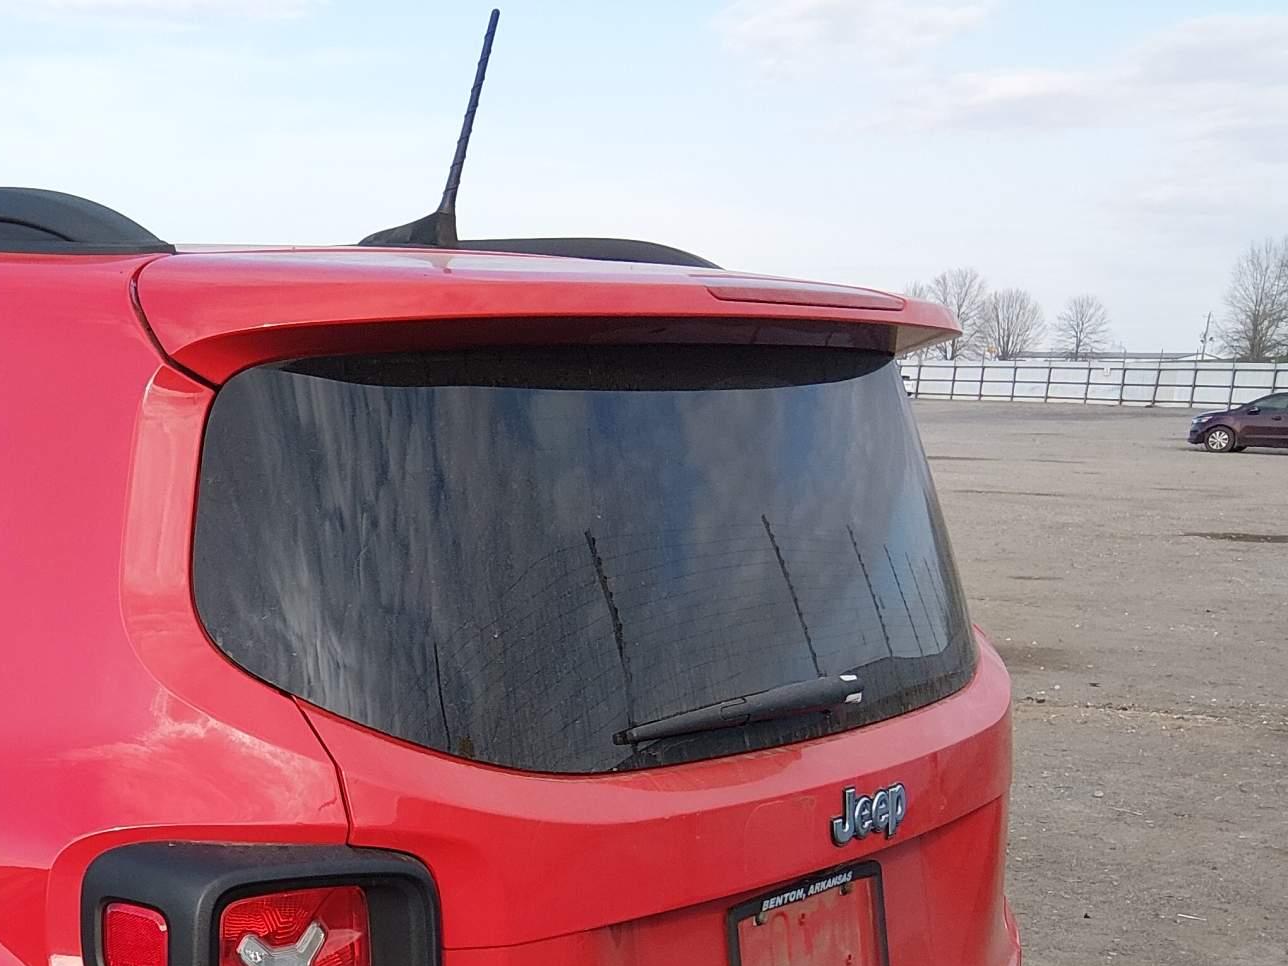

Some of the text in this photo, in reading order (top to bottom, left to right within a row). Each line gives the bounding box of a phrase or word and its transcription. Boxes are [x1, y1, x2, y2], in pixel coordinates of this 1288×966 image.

[830, 782, 906, 847] Jeep
[762, 871, 853, 912] BENTON, ARKANSAS
